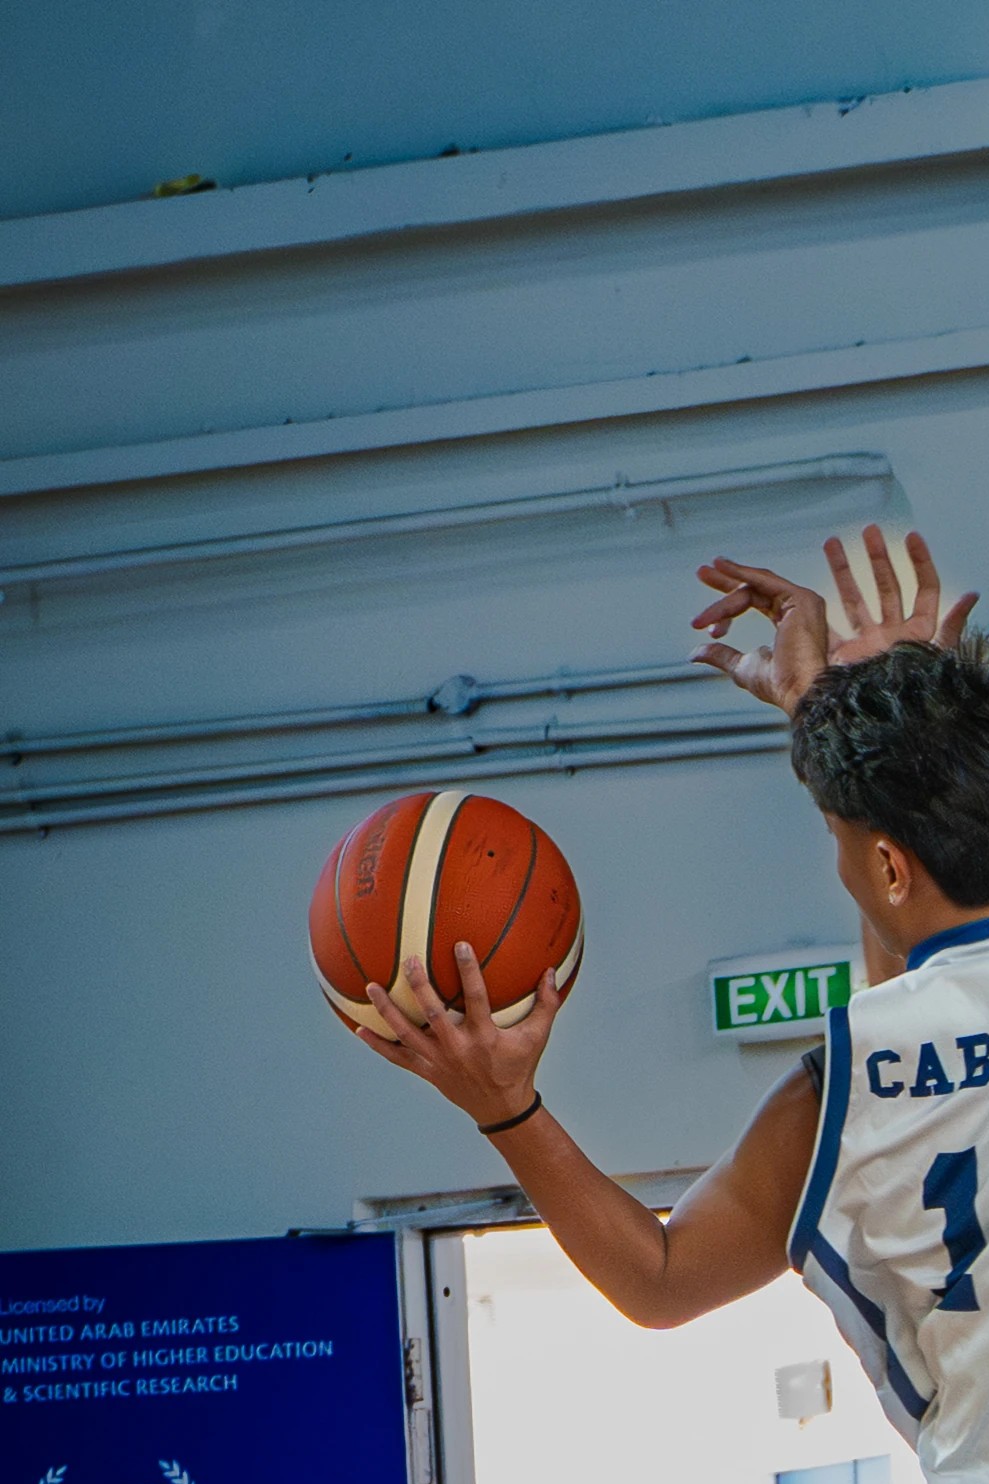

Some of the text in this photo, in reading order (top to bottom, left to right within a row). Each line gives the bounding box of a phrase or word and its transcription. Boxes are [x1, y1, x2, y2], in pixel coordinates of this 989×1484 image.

[728, 966, 837, 1025] EXIT
[0, 1294, 106, 1315] Licensed by
[0, 1315, 240, 1345] UNITED ARAB EMIRATES
[2, 1340, 334, 1374] MINISTRY OF HIGHER EDUCATION
[3, 1374, 238, 1403] & SCIENTIFIC RESEARCH
